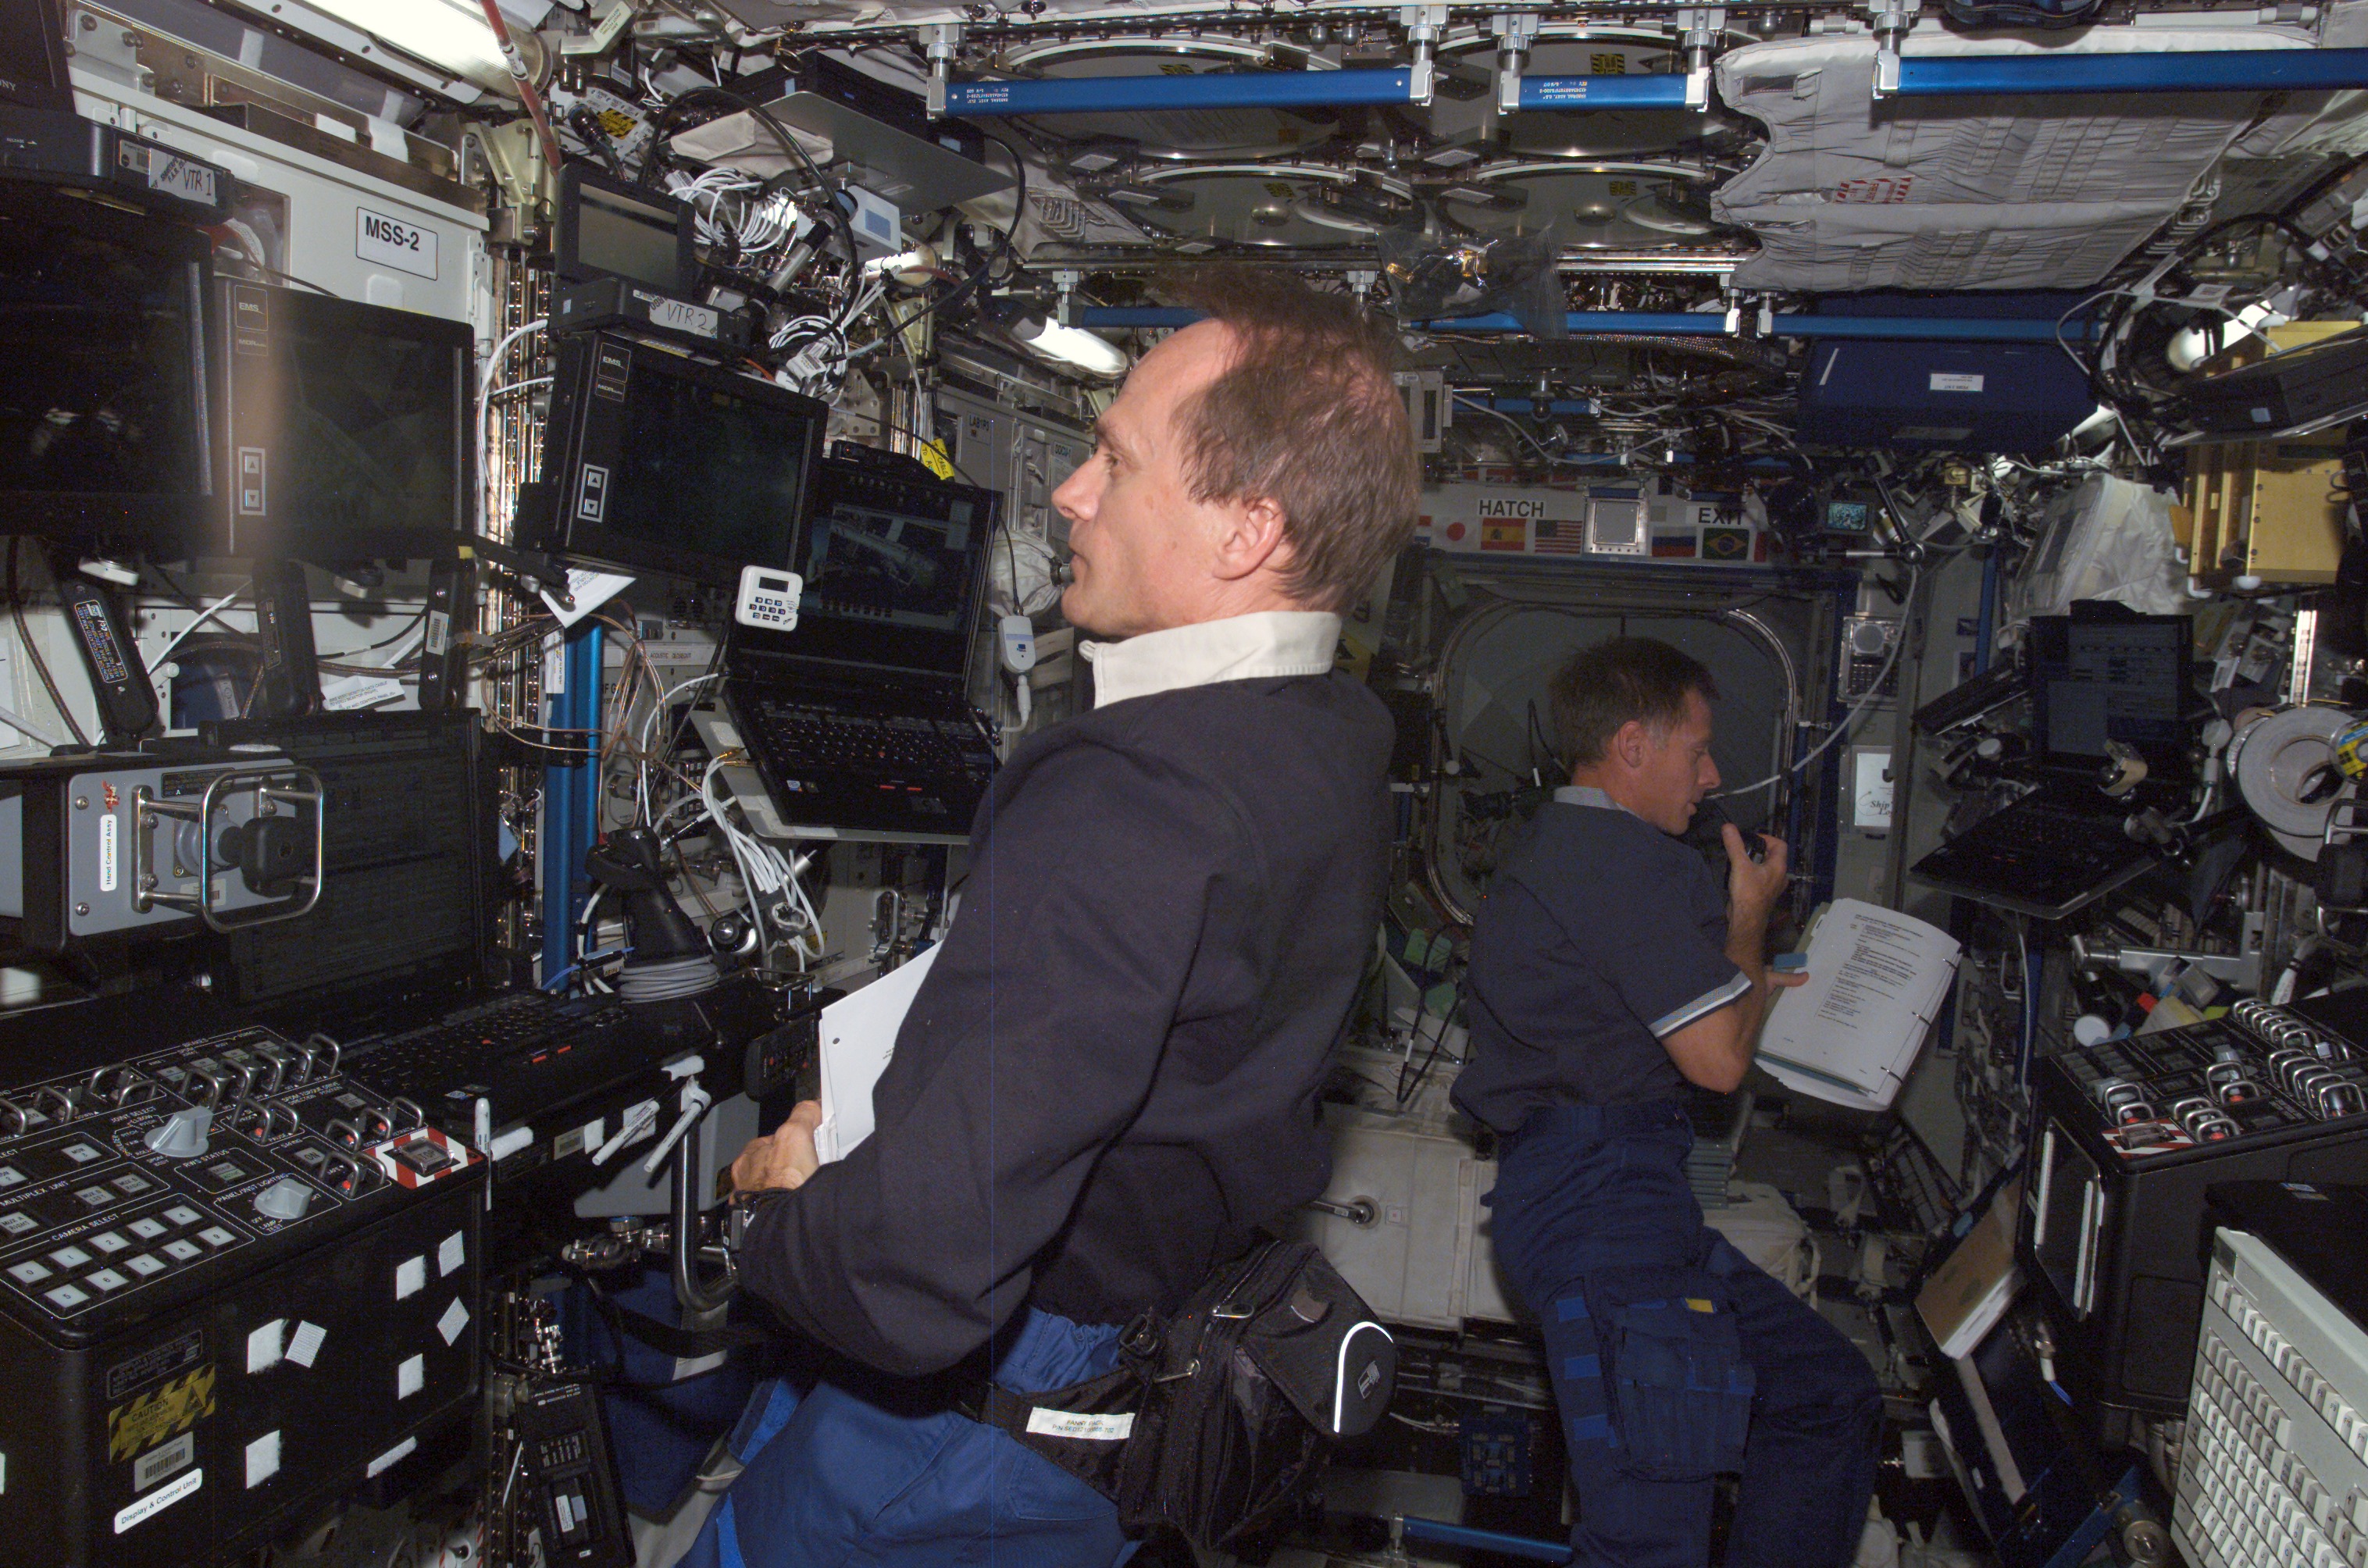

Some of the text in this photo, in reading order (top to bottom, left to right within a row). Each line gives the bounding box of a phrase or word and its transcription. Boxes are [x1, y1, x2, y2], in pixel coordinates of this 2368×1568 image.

[183, 167, 203, 191] VTR
[205, 173, 212, 195] 1
[366, 216, 419, 251] MSS-2
[239, 301, 259, 312] EMS
[667, 302, 694, 326] VTR
[697, 313, 708, 330] 2
[602, 355, 622, 367] EMS
[1479, 500, 1544, 518] HATCH
[1699, 507, 1743, 526] EXIT
[111, 1106, 156, 1124] JOINT SELECT
[183, 1149, 230, 1168] RWS STATUS
[305, 1152, 319, 1161] ON
[0, 1180, 70, 1206] MULTIPLEX UNIT
[126, 1181, 144, 1190] RIGHT
[9, 1221, 30, 1230] RIGHT
[52, 1213, 119, 1242] CAMERA SELECT
[131, 1397, 169, 1423] CAUTION
[121, 1505, 148, 1525] Display
[155, 1486, 182, 1504] Control
[181, 1477, 198, 1491] Unit
